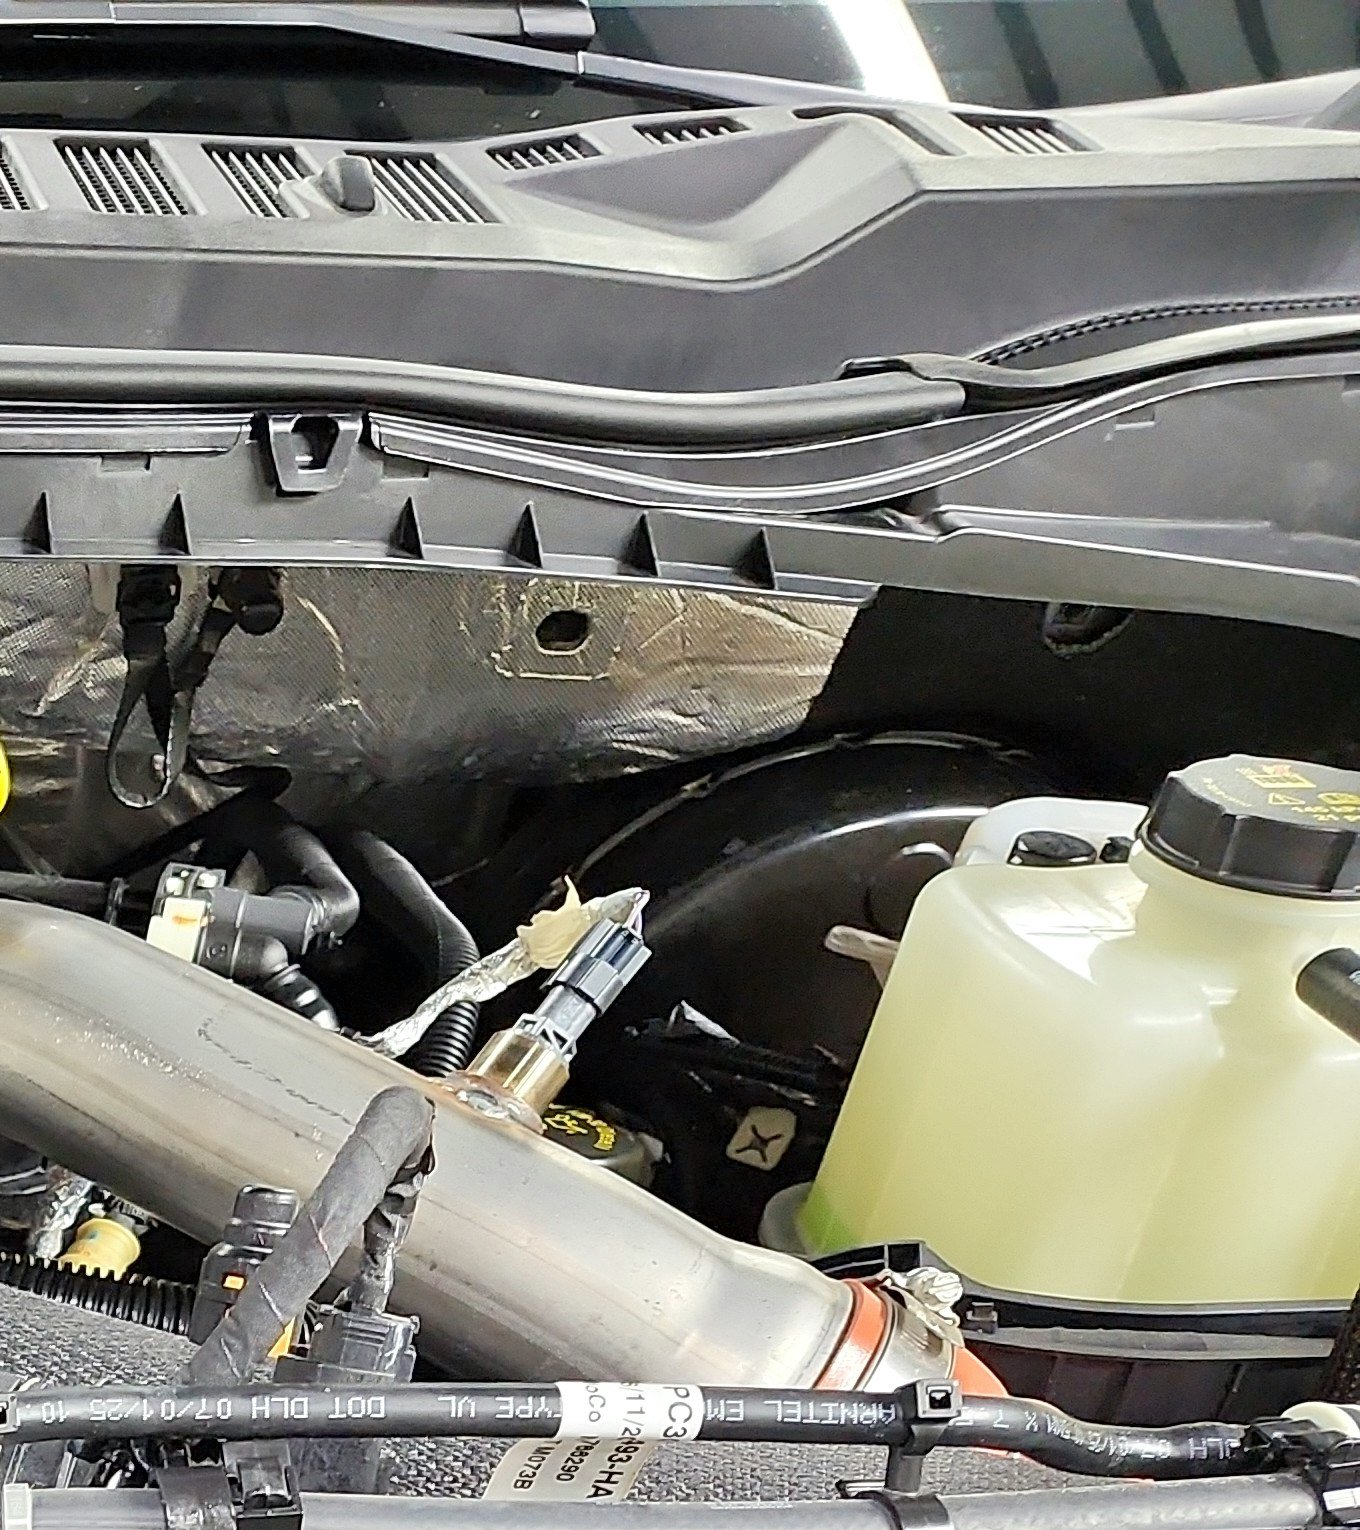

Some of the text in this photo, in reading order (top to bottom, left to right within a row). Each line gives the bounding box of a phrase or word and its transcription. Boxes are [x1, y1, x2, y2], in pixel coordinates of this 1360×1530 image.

[88, 1398, 232, 1422] 07/01/25
[249, 1396, 309, 1420] DLH
[327, 1396, 386, 1419] DOT
[763, 1399, 897, 1426] ARNITEL
